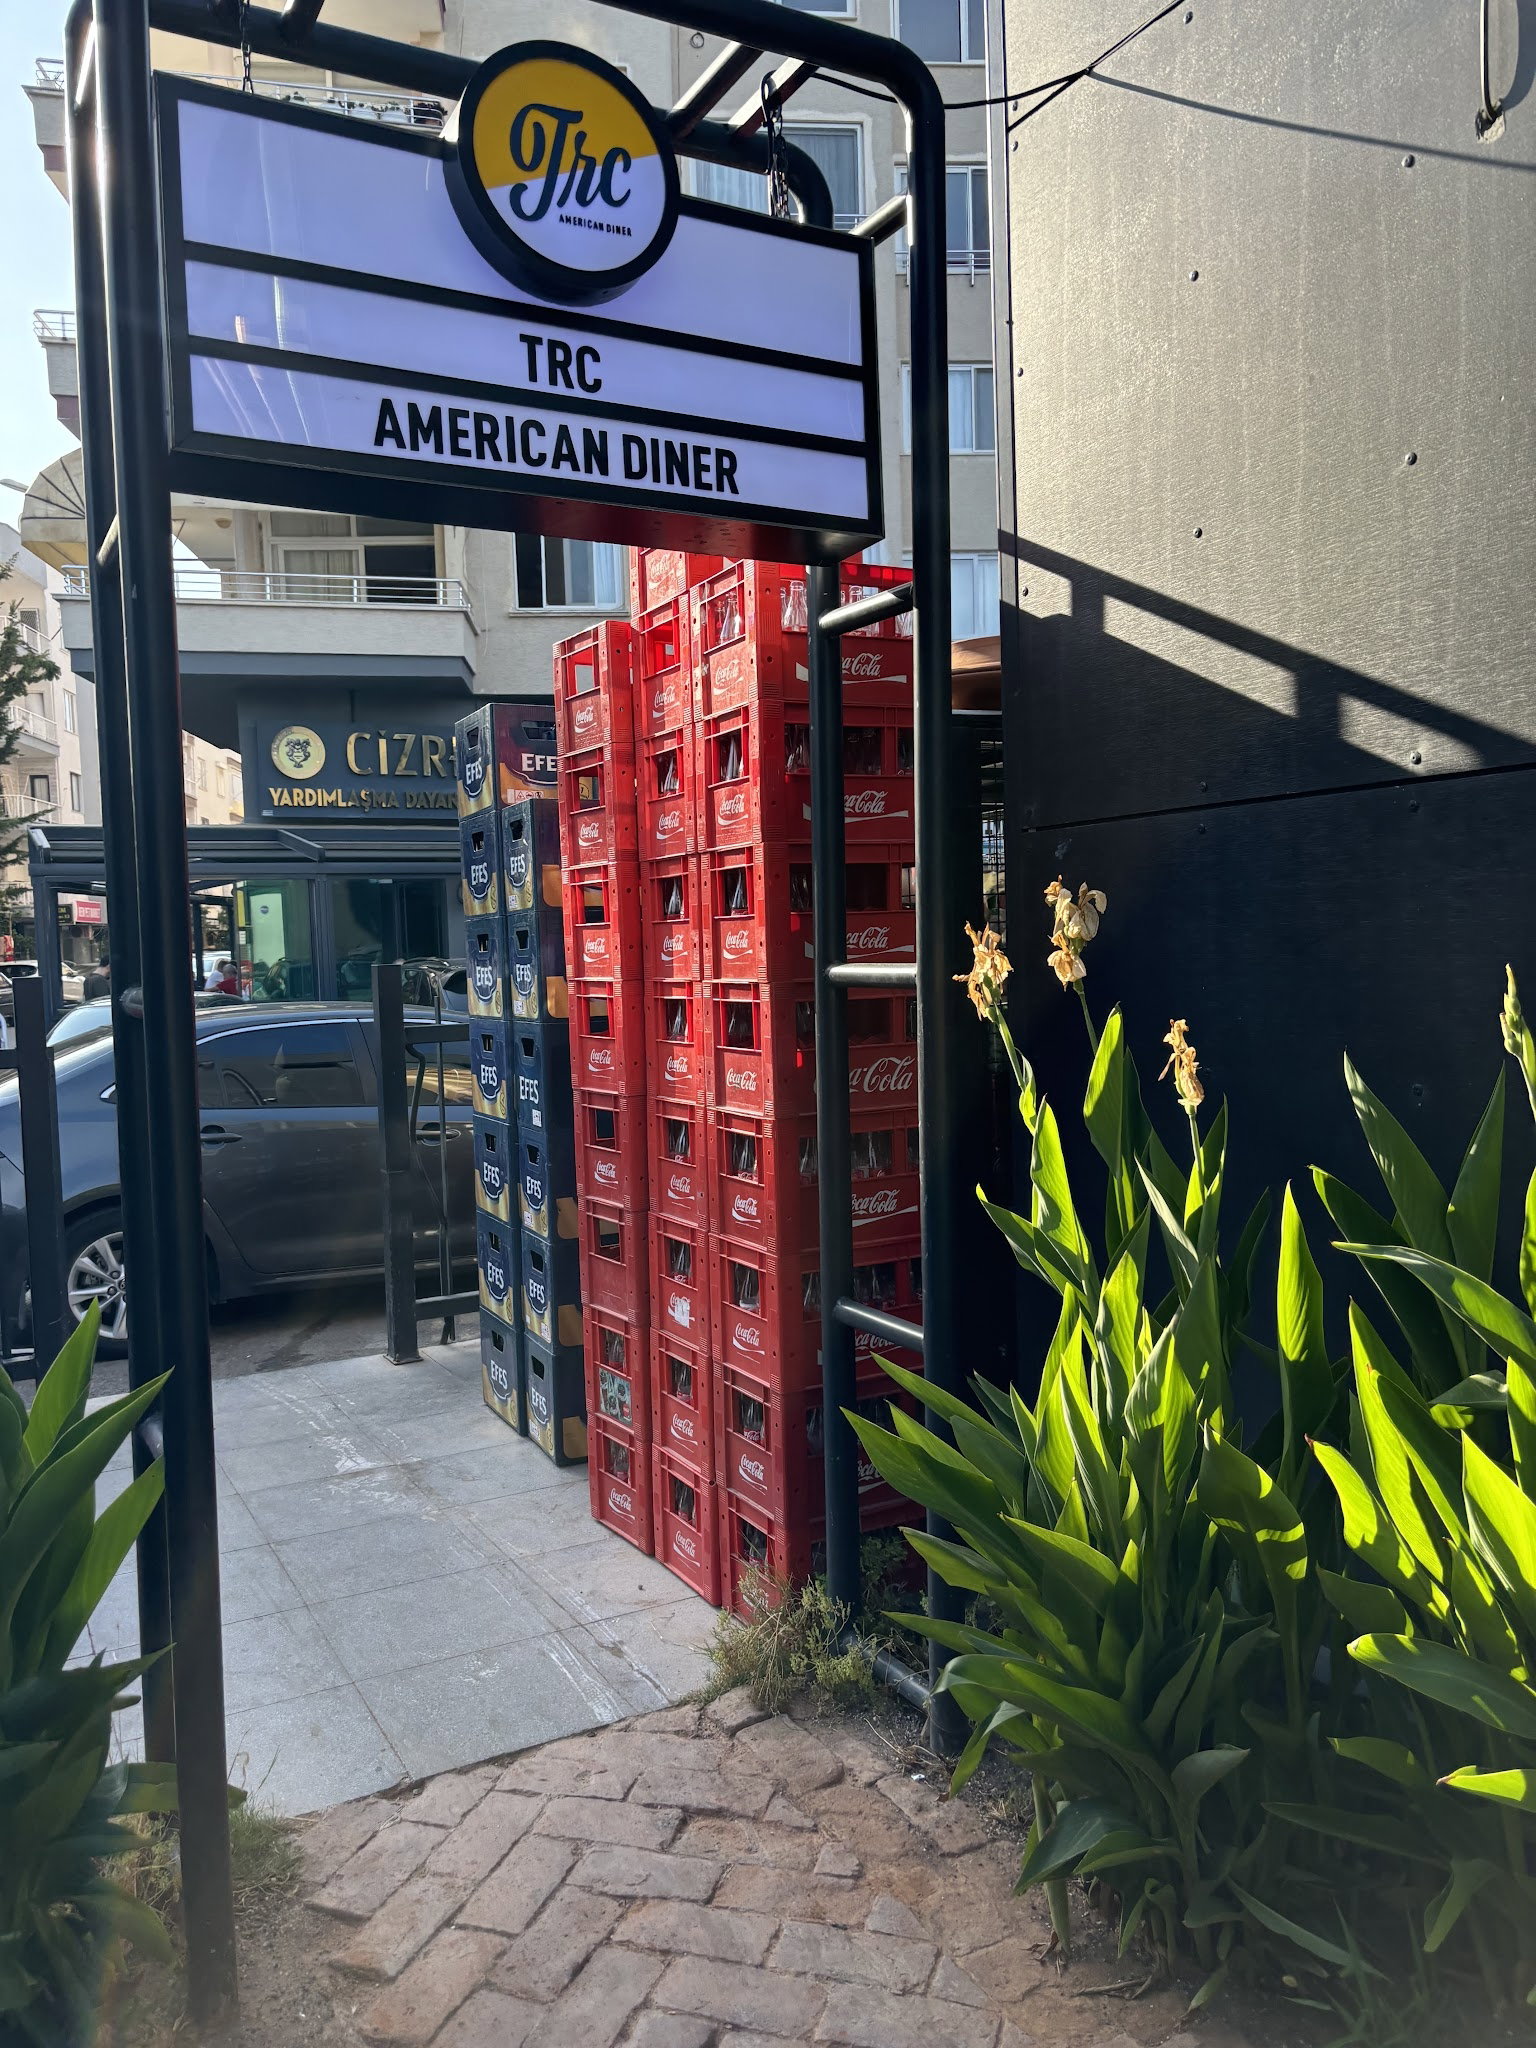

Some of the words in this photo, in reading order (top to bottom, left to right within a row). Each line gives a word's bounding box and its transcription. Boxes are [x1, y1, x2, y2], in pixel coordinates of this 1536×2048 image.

[509, 103, 632, 222] Trc
[559, 214, 605, 232] AMERICAN
[606, 226, 632, 237] DINER
[519, 333, 602, 394] TRC
[373, 397, 610, 476] AMERICAN
[623, 434, 740, 495] DINER
[346, 730, 457, 777] CİZR
[522, 753, 558, 771] EFE
[465, 757, 483, 785] EFES
[470, 862, 488, 886] EFES
[510, 853, 526, 876] EFES
[476, 965, 493, 987] EFES
[516, 963, 531, 983] EFES
[480, 1064, 497, 1087] EFES
[726, 1068, 758, 1092] Coca-Cola
[519, 1075, 539, 1104] EFES
[483, 1161, 500, 1188] EFES
[526, 1177, 542, 1200] EFES
[487, 1261, 504, 1290] EFES
[529, 1278, 546, 1304] EFES
[490, 1360, 508, 1390] EFES
[531, 1387, 547, 1416] EFES
